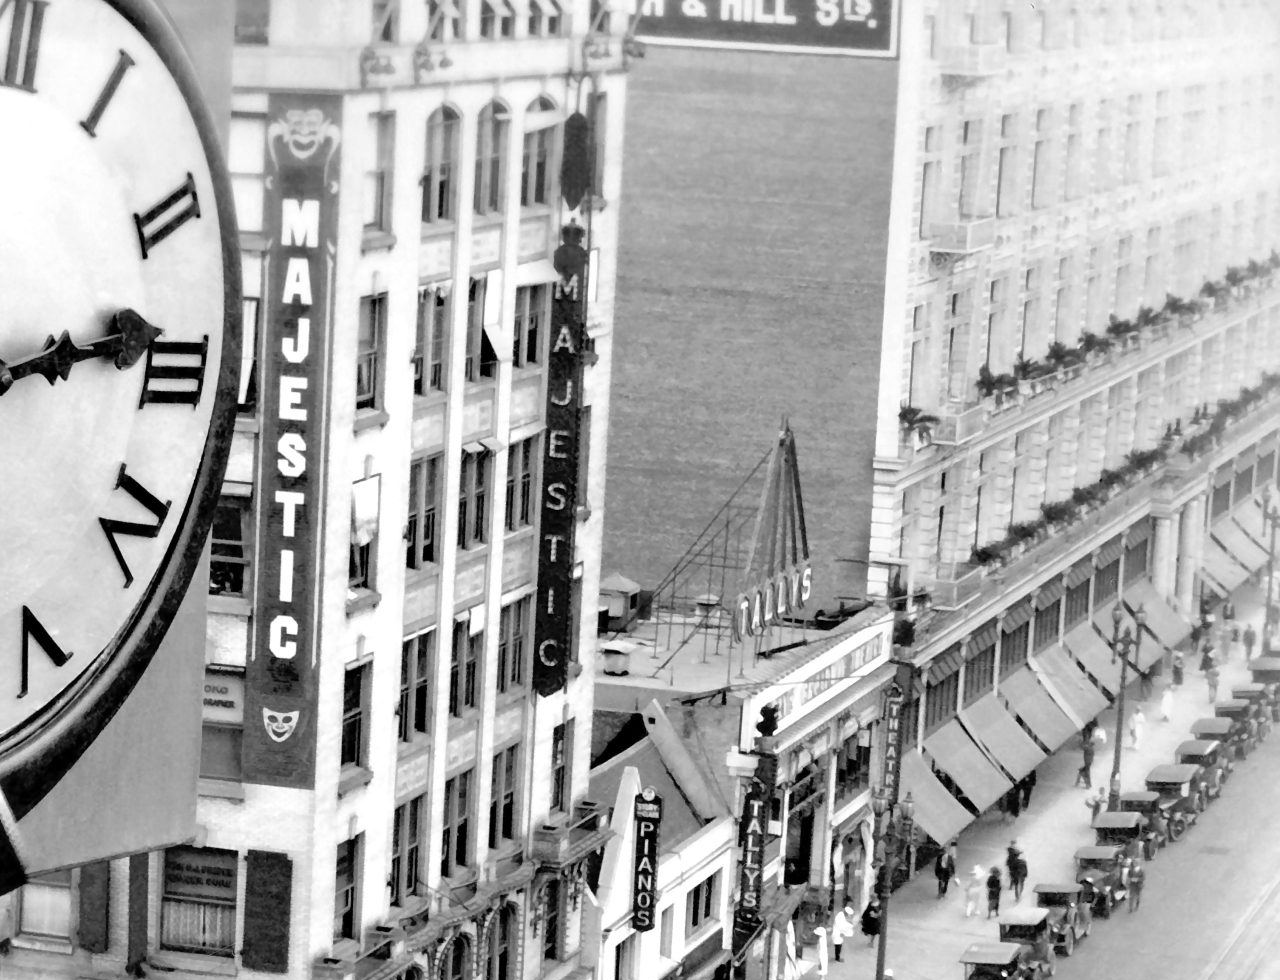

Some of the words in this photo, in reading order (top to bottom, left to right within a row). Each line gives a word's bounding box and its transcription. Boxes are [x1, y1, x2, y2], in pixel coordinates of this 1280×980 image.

[80, 49, 137, 138] I
[133, 172, 202, 260] II
[139, 334, 210, 411] III
[269, 198, 320, 660] MAJESTIC
[537, 272, 579, 668] MAJESTIC
[98, 463, 172, 589] IV
[17, 604, 74, 699] V
[636, 821, 655, 927] PIANOS
